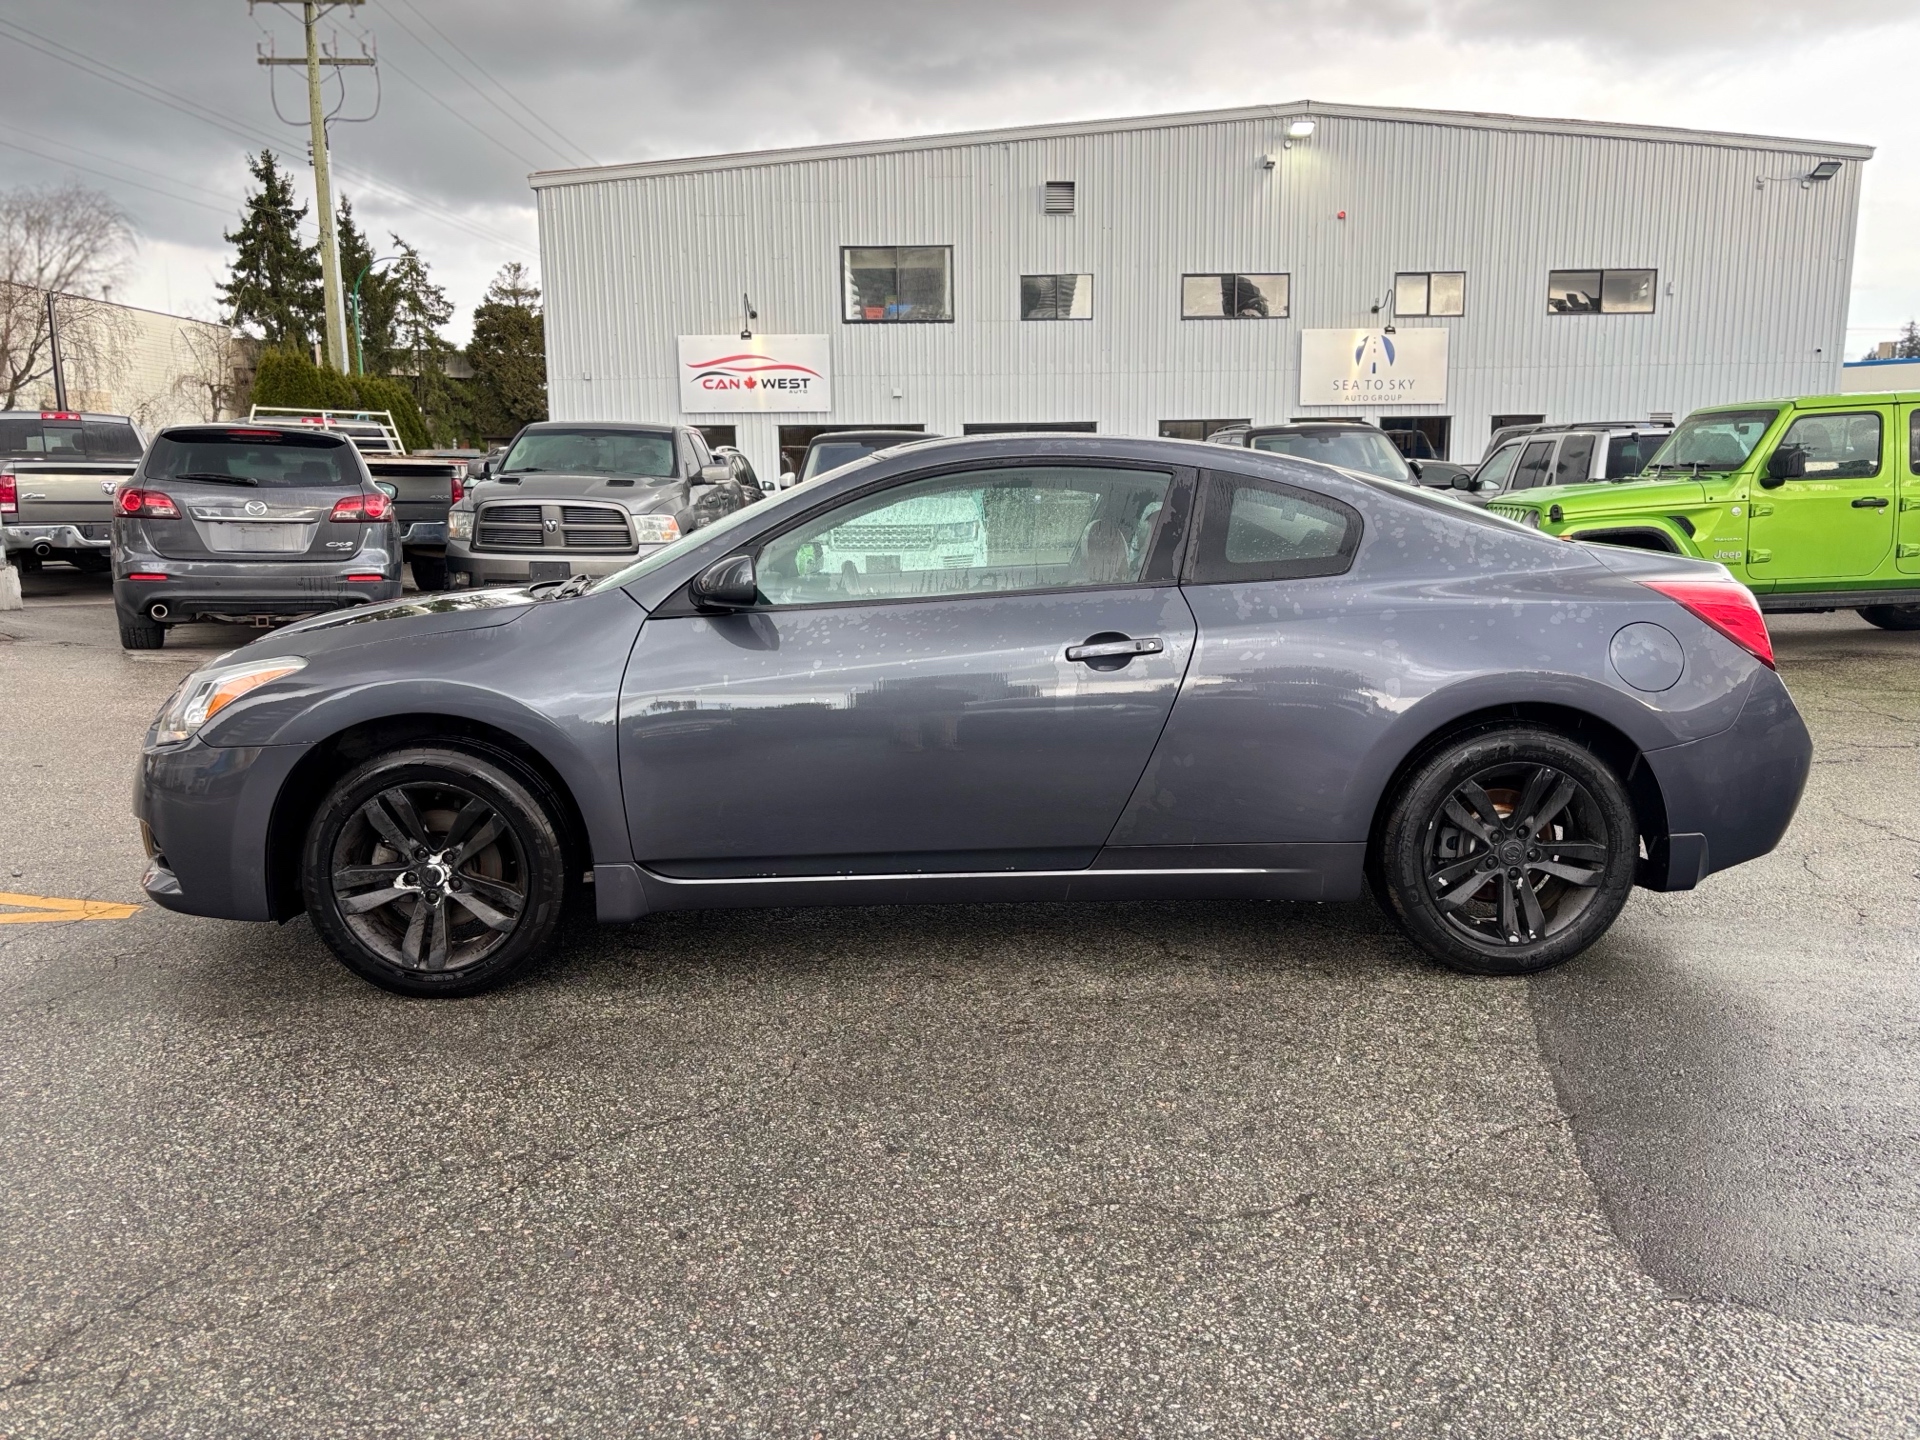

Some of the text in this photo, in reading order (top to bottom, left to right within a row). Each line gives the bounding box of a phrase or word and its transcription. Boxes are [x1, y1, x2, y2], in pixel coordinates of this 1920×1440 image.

[702, 378, 811, 390] CAN WEST
[1333, 379, 1416, 391] SEA TO SKY
[1713, 549, 1742, 560] Jeep
